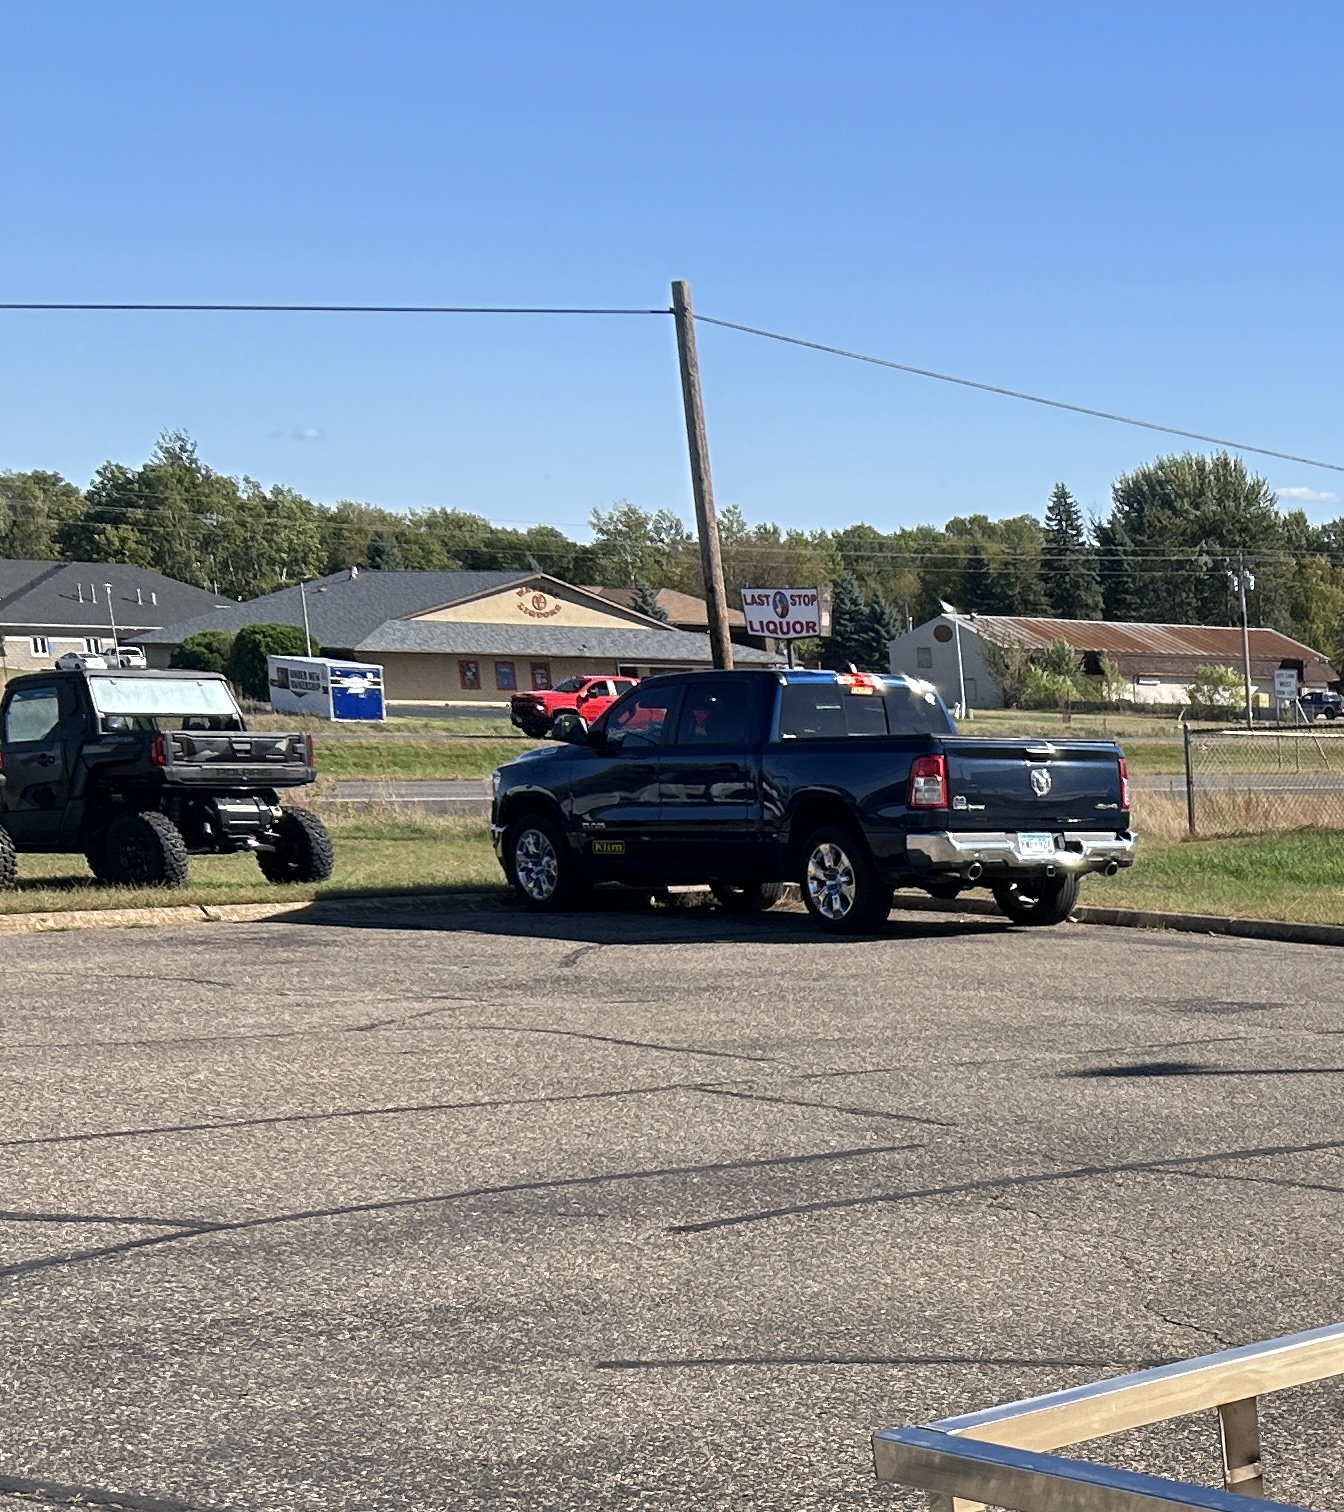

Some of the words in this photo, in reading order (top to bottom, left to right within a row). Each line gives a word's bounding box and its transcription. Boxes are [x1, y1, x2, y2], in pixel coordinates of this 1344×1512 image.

[743, 594, 770, 606] LAST
[790, 594, 817, 606] STOP
[749, 621, 817, 635] LIQUOR
[594, 842, 623, 852] Klim
